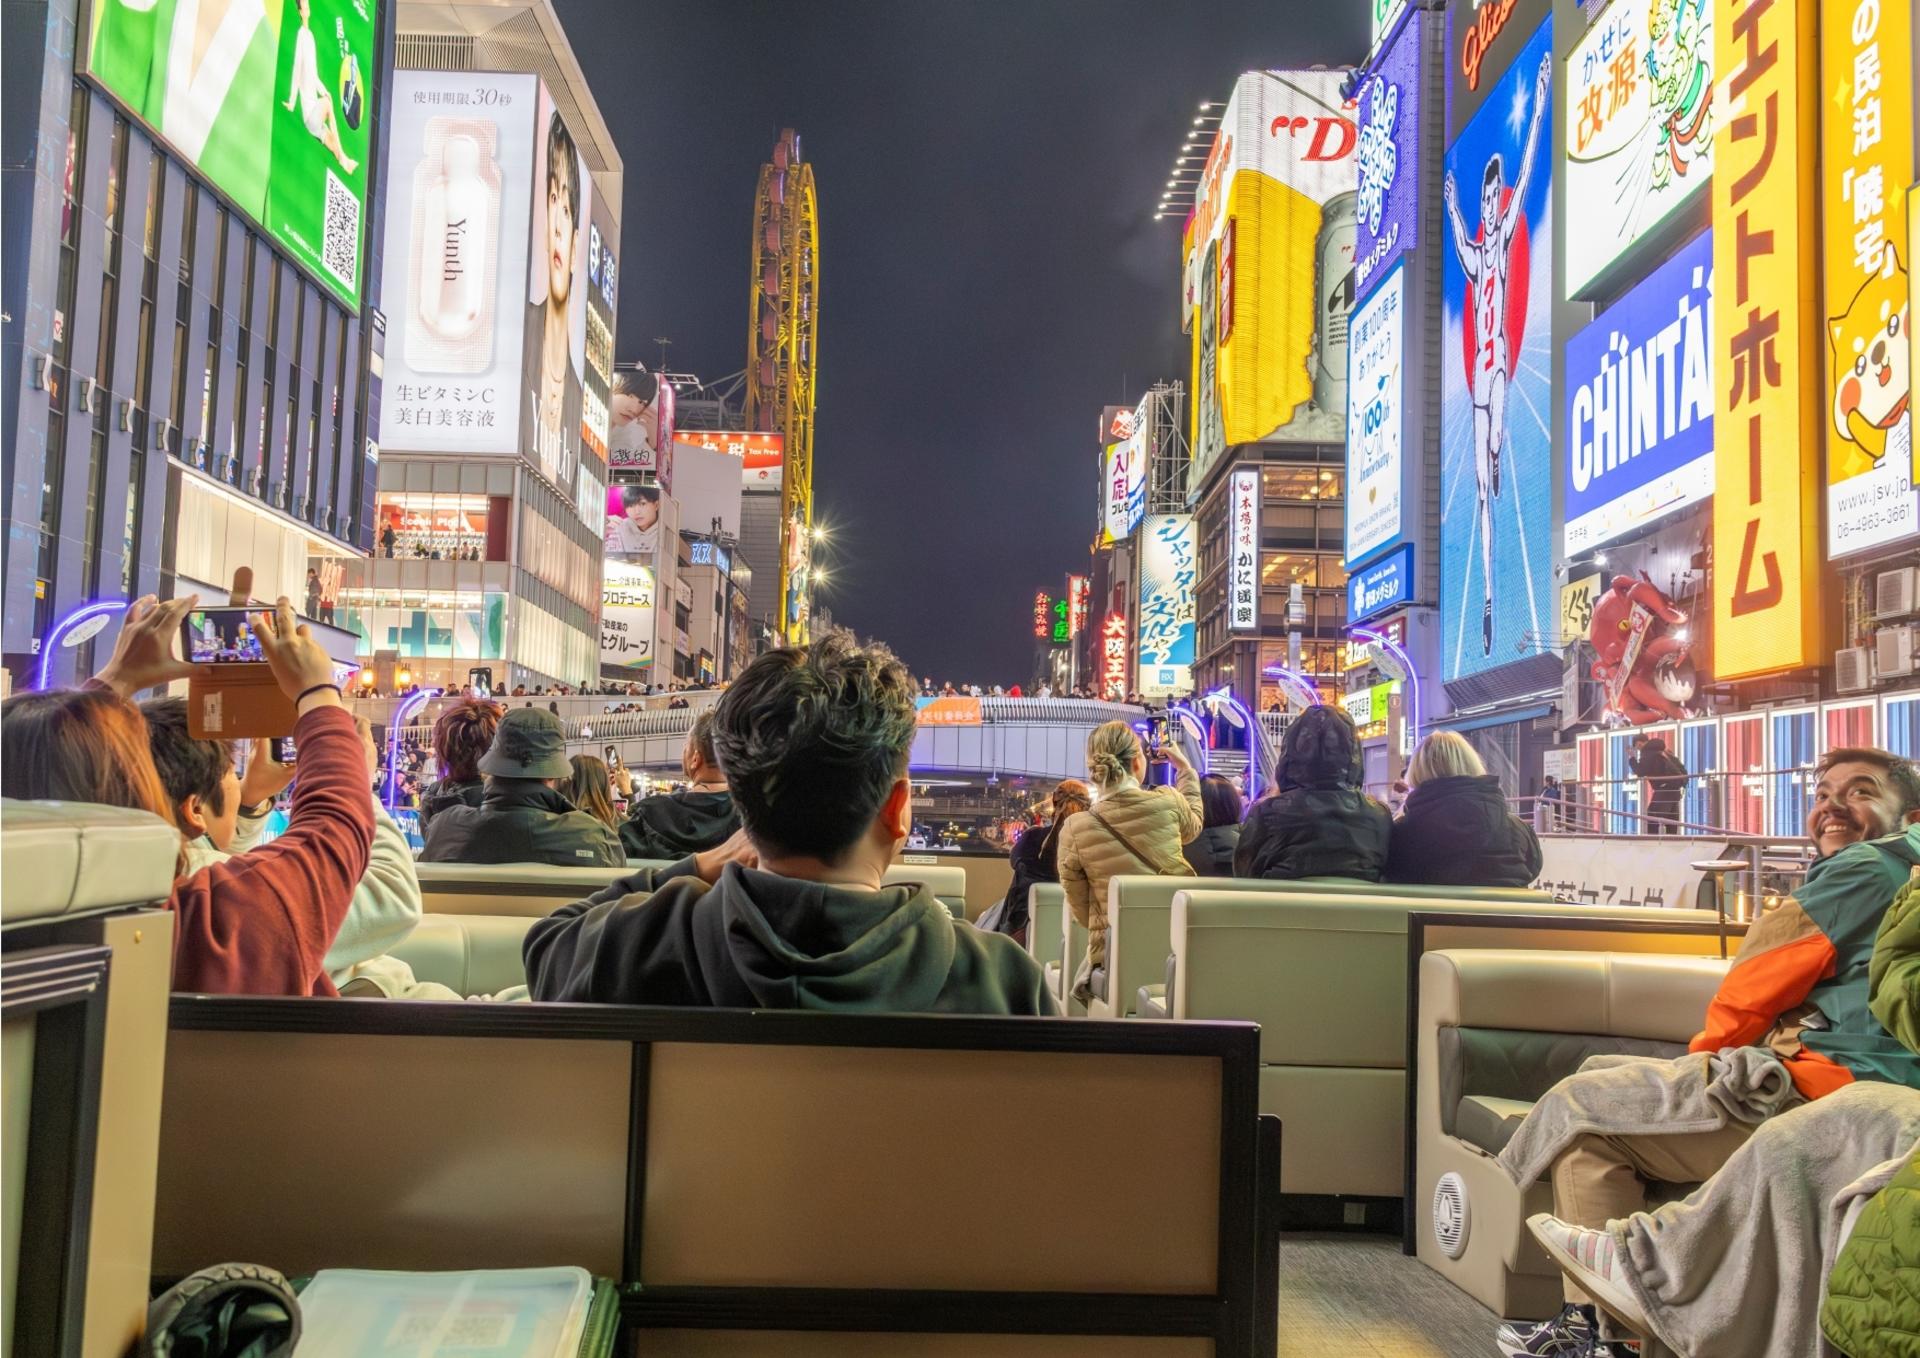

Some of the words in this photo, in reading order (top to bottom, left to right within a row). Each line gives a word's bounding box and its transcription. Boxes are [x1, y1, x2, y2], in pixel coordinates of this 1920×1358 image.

[1582, 10, 1632, 87] かぜに
[1577, 36, 1638, 154] 改源
[444, 217, 467, 282] Yunth
[1484, 267, 1497, 371] グリコ
[395, 407, 495, 428] 美白美容液
[396, 383, 496, 405] 生ビタミンC
[1838, 476, 1908, 512] www.jsv.jp
[1837, 503, 1910, 539] 06-4963-3661
